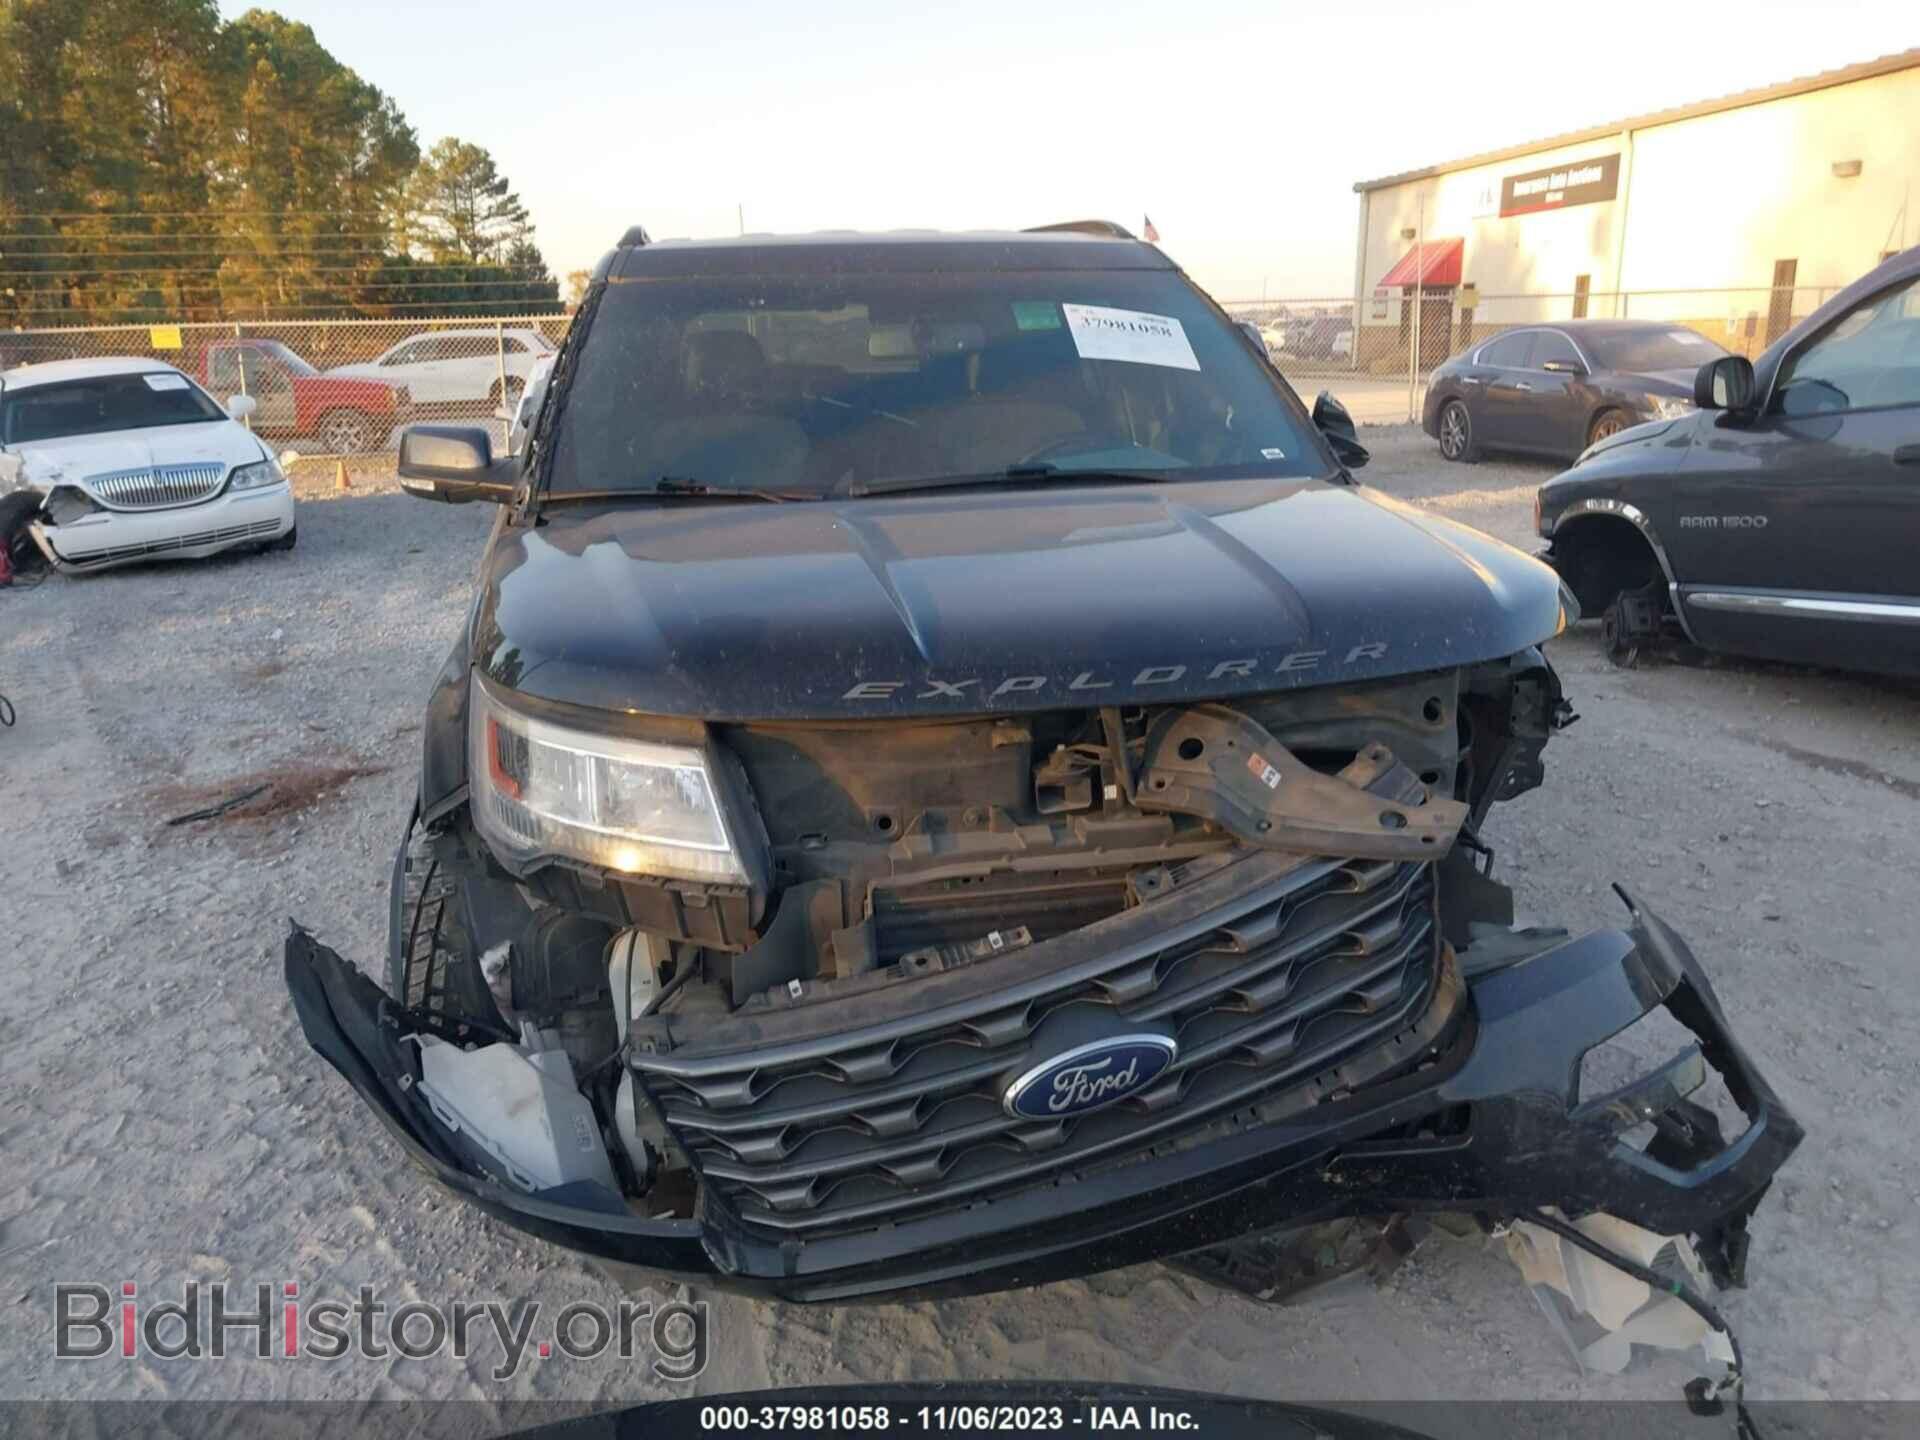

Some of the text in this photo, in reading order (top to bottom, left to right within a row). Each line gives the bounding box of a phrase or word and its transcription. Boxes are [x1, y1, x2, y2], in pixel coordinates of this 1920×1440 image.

[1680, 515, 1769, 528] RAM 1500
[842, 641, 1390, 701] EXPLORER
[1048, 1056, 1140, 1112] Ford
